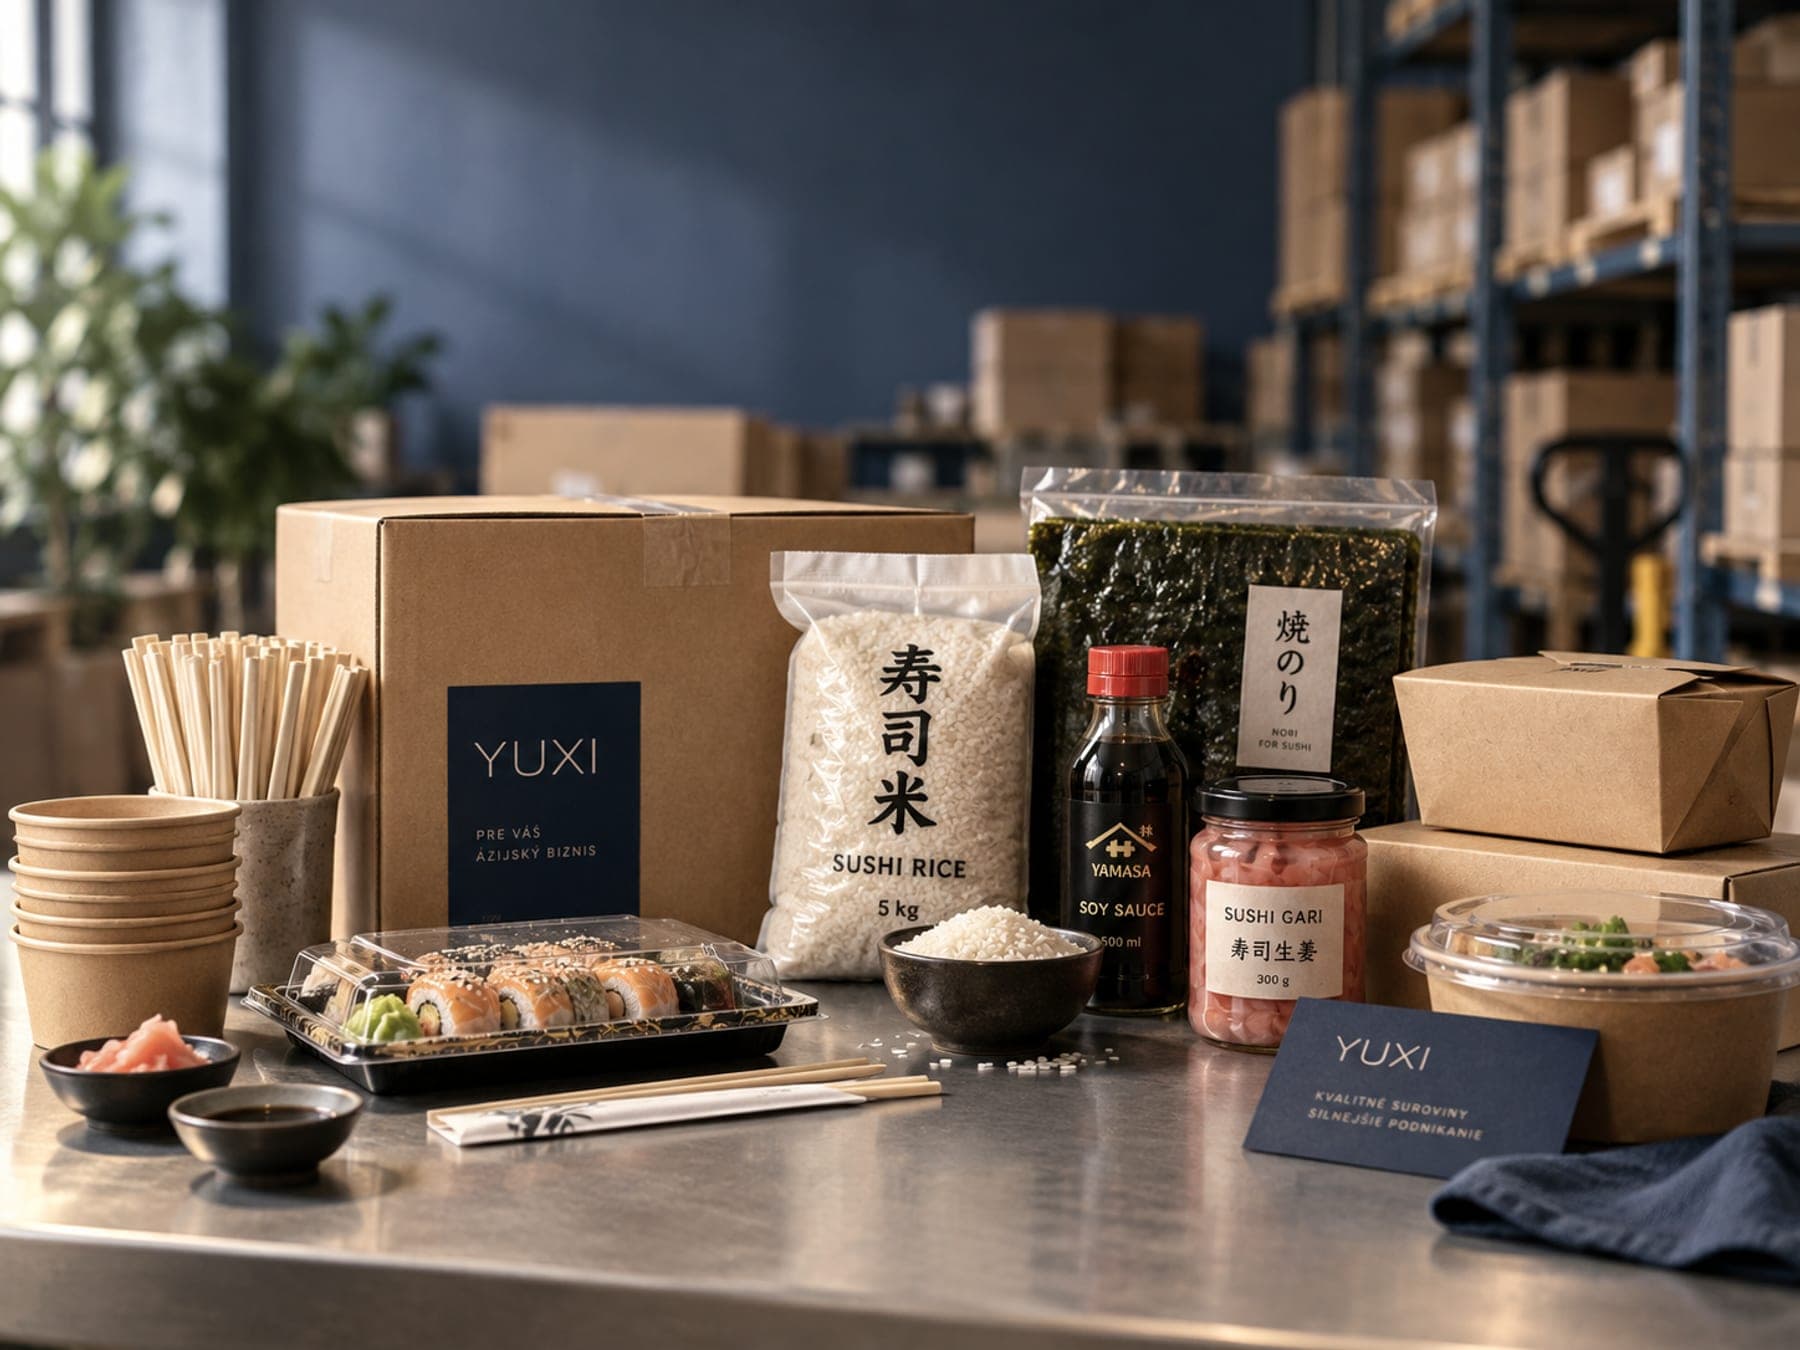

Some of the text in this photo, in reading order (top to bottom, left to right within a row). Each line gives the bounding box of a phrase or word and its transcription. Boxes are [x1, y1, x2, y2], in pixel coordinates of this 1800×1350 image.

[1275, 610, 1311, 716] 焼のり
[867, 643, 943, 836] 寿司米
[1258, 739, 1312, 752] FOR SUSHI
[474, 737, 597, 778] YUXI
[476, 828, 505, 841] PRE
[546, 844, 597, 859] BIZNIS
[832, 853, 967, 879] SUSHI RICE
[1091, 862, 1152, 878] YAMASA
[878, 899, 919, 922] 5 kg
[1079, 900, 1165, 917] SOY SAUCE
[1224, 906, 1322, 925] SUSHI GARI
[1101, 936, 1142, 948] 500 ml
[1256, 974, 1290, 988] 300 g
[1336, 1034, 1431, 1071] YUXI
[1391, 1100, 1469, 1121] SUROVINY
[1388, 1117, 1484, 1142] PODNIKANIE
